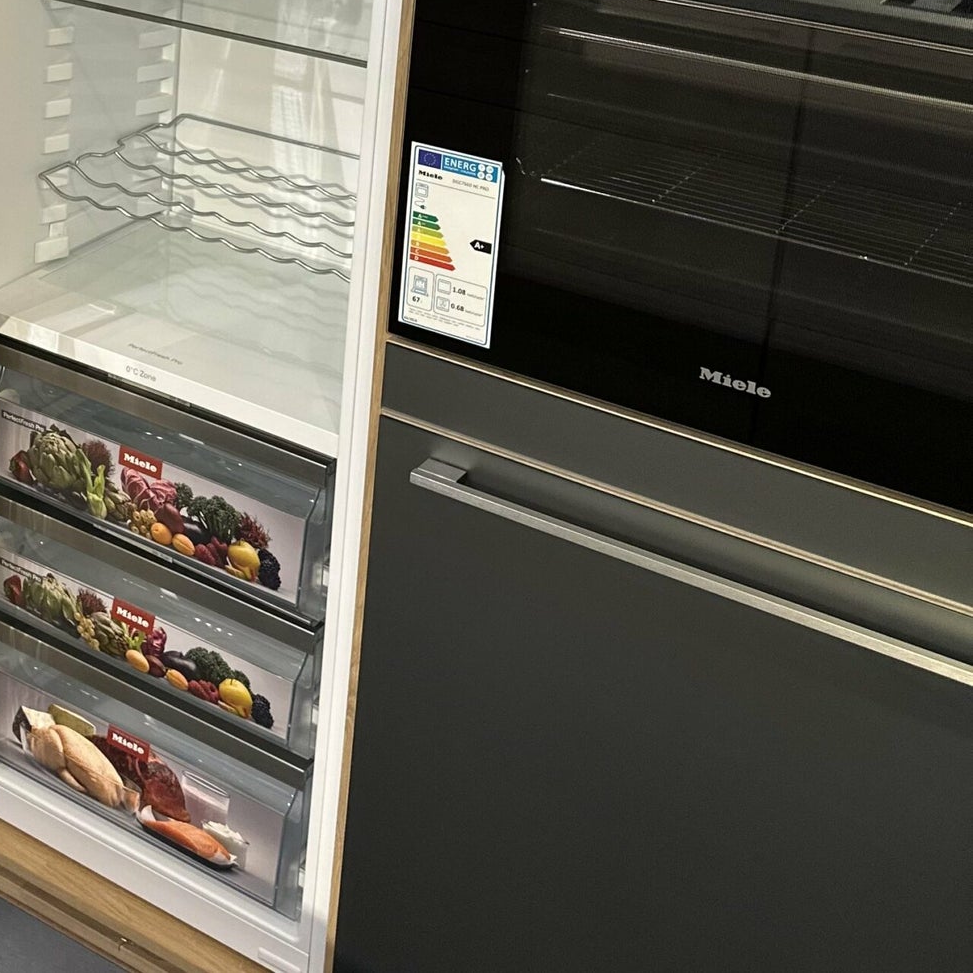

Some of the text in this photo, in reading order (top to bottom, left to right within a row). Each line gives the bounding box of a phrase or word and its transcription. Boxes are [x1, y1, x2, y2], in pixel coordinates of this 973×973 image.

[418, 169, 443, 180] Miele
[444, 157, 477, 172] ENERG
[139, 370, 157, 382] Zone
[698, 366, 772, 398] Miele
[123, 452, 158, 473] Miele
[116, 606, 150, 628] Miele
[111, 732, 145, 755] Miele
